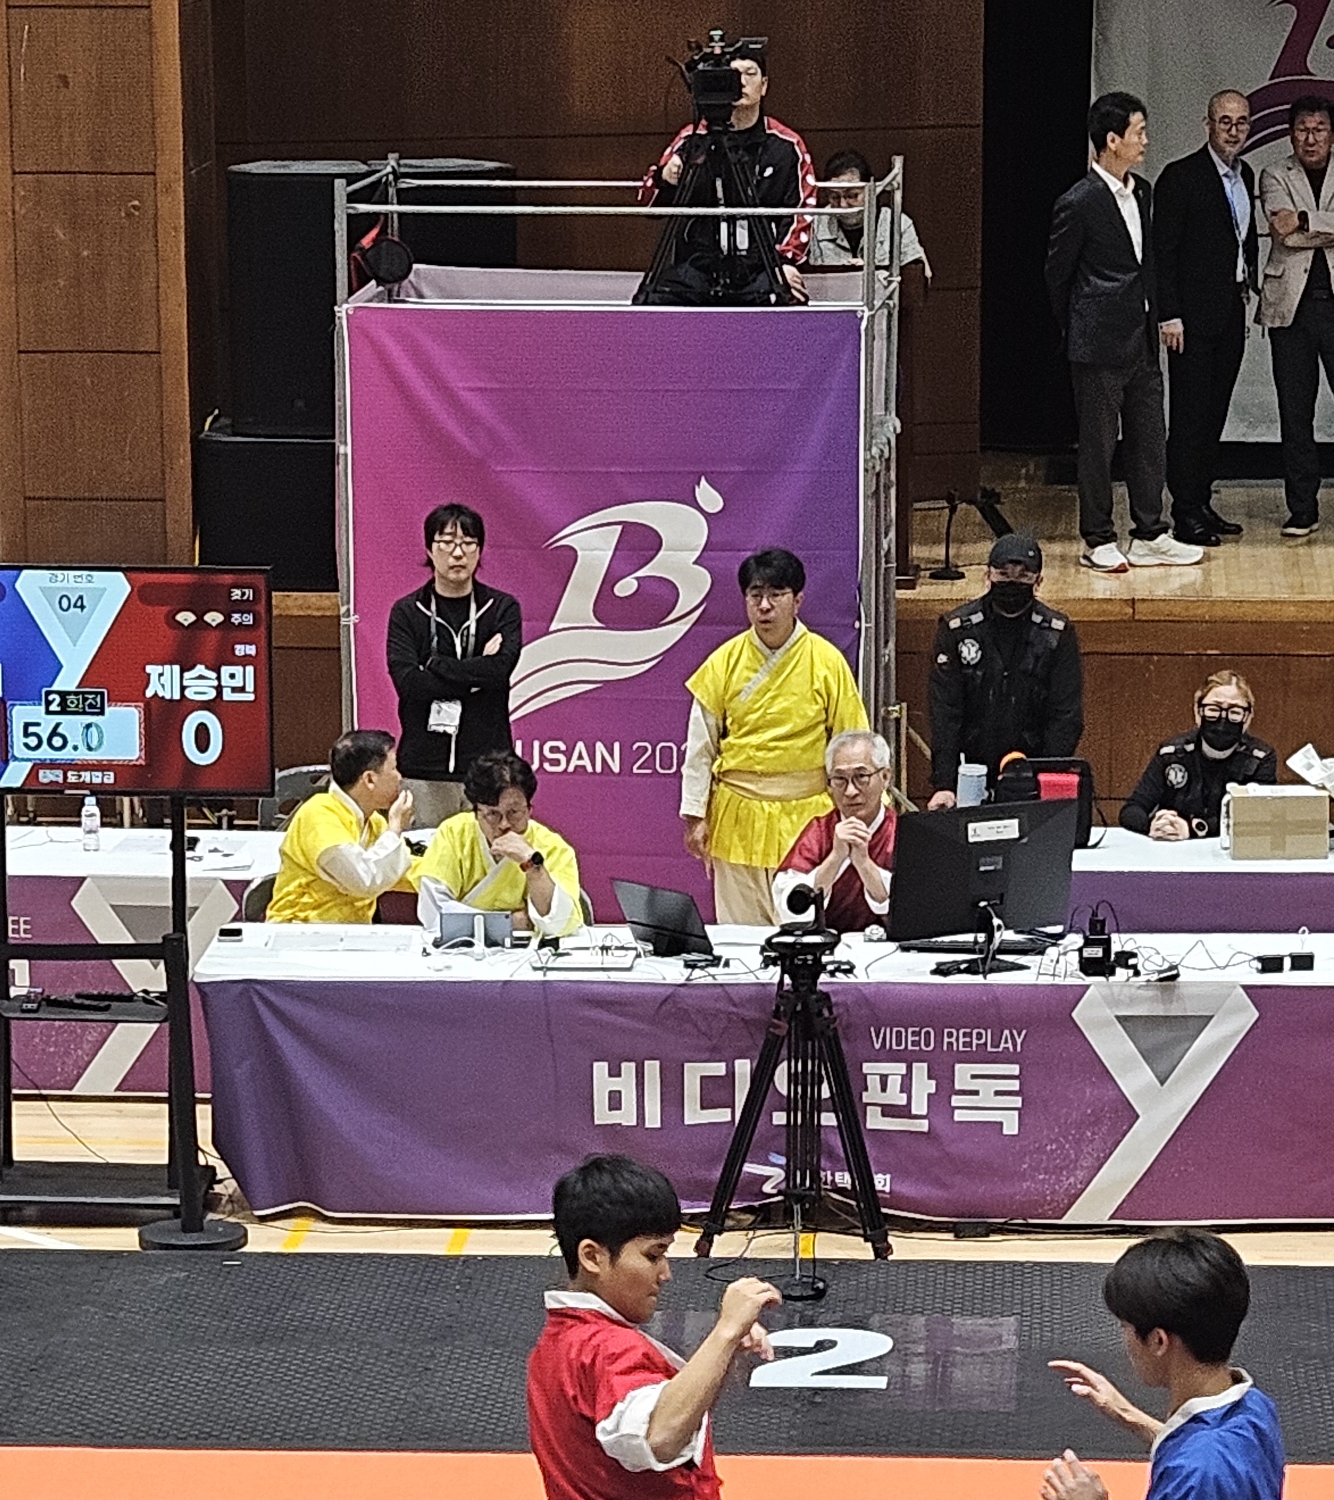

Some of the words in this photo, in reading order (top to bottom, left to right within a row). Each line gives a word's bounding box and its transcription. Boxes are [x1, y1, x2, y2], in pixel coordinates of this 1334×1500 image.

[58, 594, 87, 613] 04
[144, 663, 256, 701] 제승민
[47, 693, 62, 711] 2
[181, 709, 223, 766] 0
[515, 739, 621, 774] USAN
[632, 741, 688, 774] 20
[870, 1026, 935, 1051] VIDEO
[943, 1028, 1027, 1053] REPLAY
[748, 1327, 894, 1390] 2
